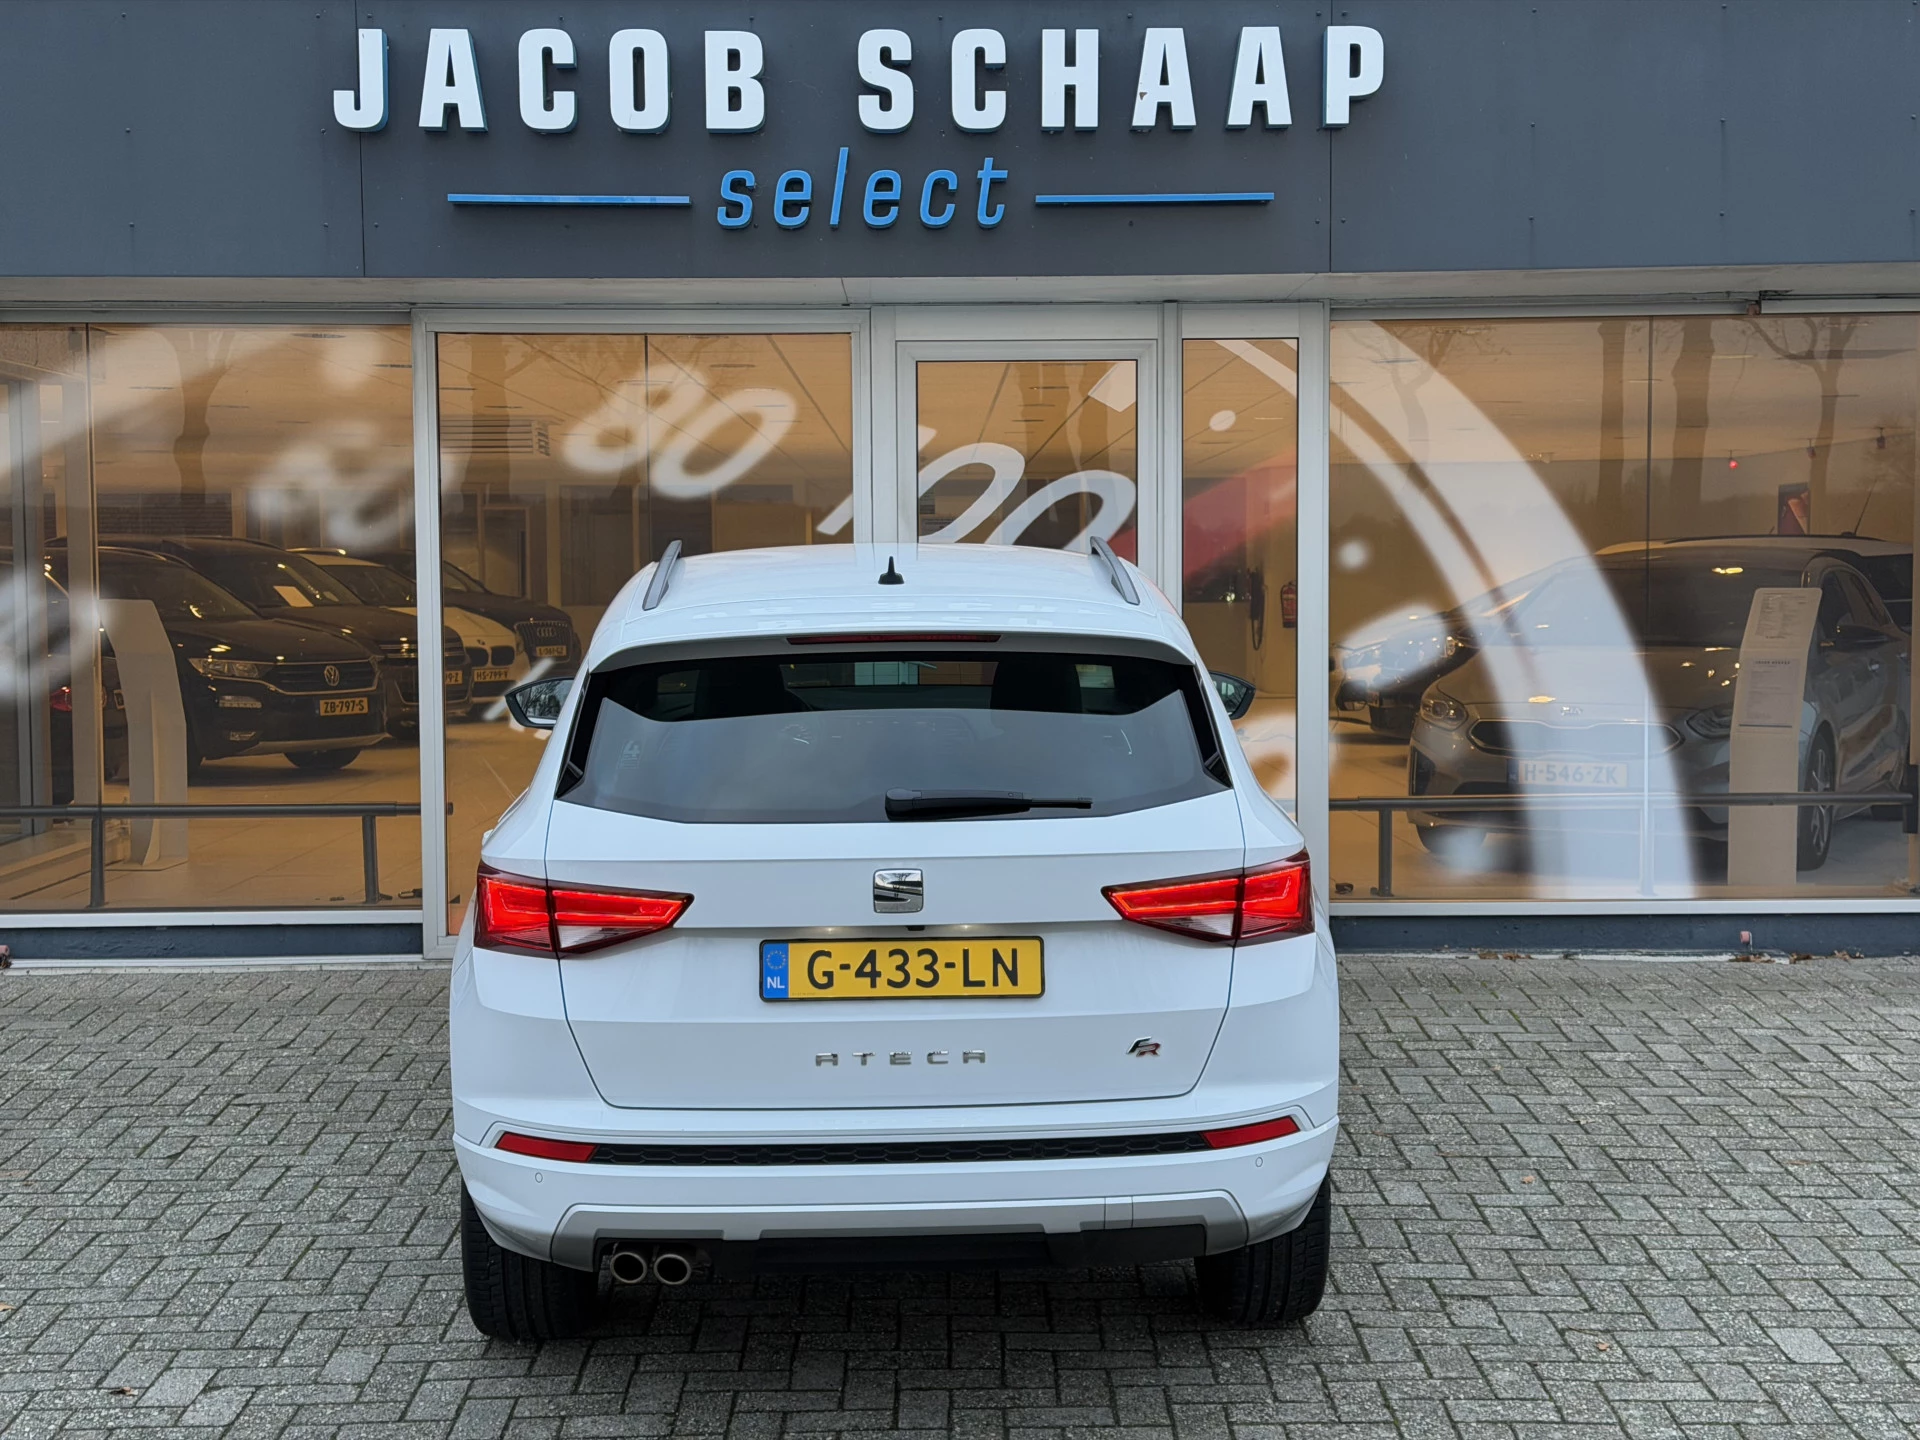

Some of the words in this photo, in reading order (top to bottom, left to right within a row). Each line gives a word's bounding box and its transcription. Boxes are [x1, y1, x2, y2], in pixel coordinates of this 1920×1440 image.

[333, 28, 766, 133] JACOB
[858, 26, 1385, 133] SCHAAP
[717, 147, 1008, 229] select
[324, 699, 364, 713] ZB-797-S
[1525, 763, 1618, 785] H-546-ZK
[767, 976, 785, 989] NL
[807, 948, 1018, 990] G-433-LN
[815, 1049, 986, 1066] ATECA
